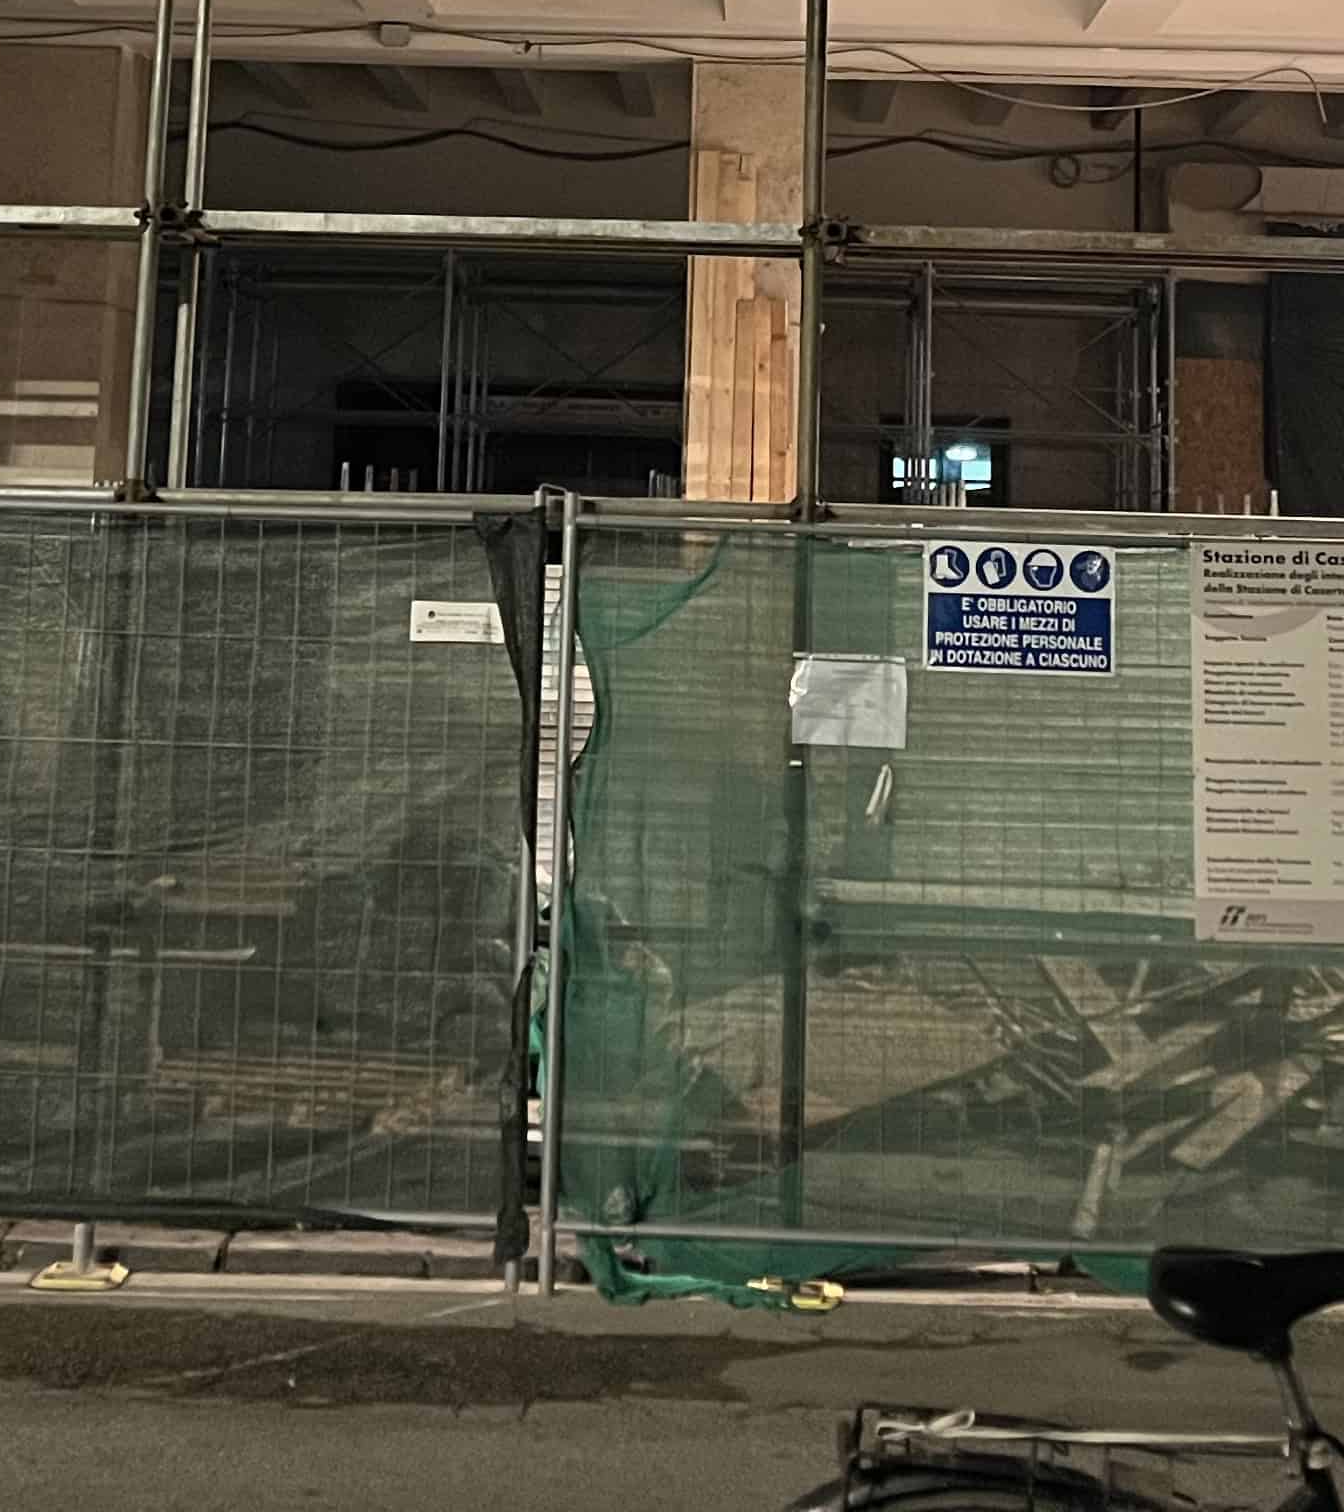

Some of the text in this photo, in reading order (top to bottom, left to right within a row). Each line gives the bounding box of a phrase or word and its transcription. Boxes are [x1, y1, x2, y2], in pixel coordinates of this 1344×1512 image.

[1203, 549, 1286, 564] Stazione
[1292, 550, 1309, 565] di
[961, 597, 1077, 615] E' OBBLIGATORIO
[962, 615, 1076, 632] USARE I MEZZI DI
[935, 632, 1103, 651] PROTEZIONE PERSONALE
[931, 649, 1107, 669] IN DOTAZIONE A CIASCUNO
